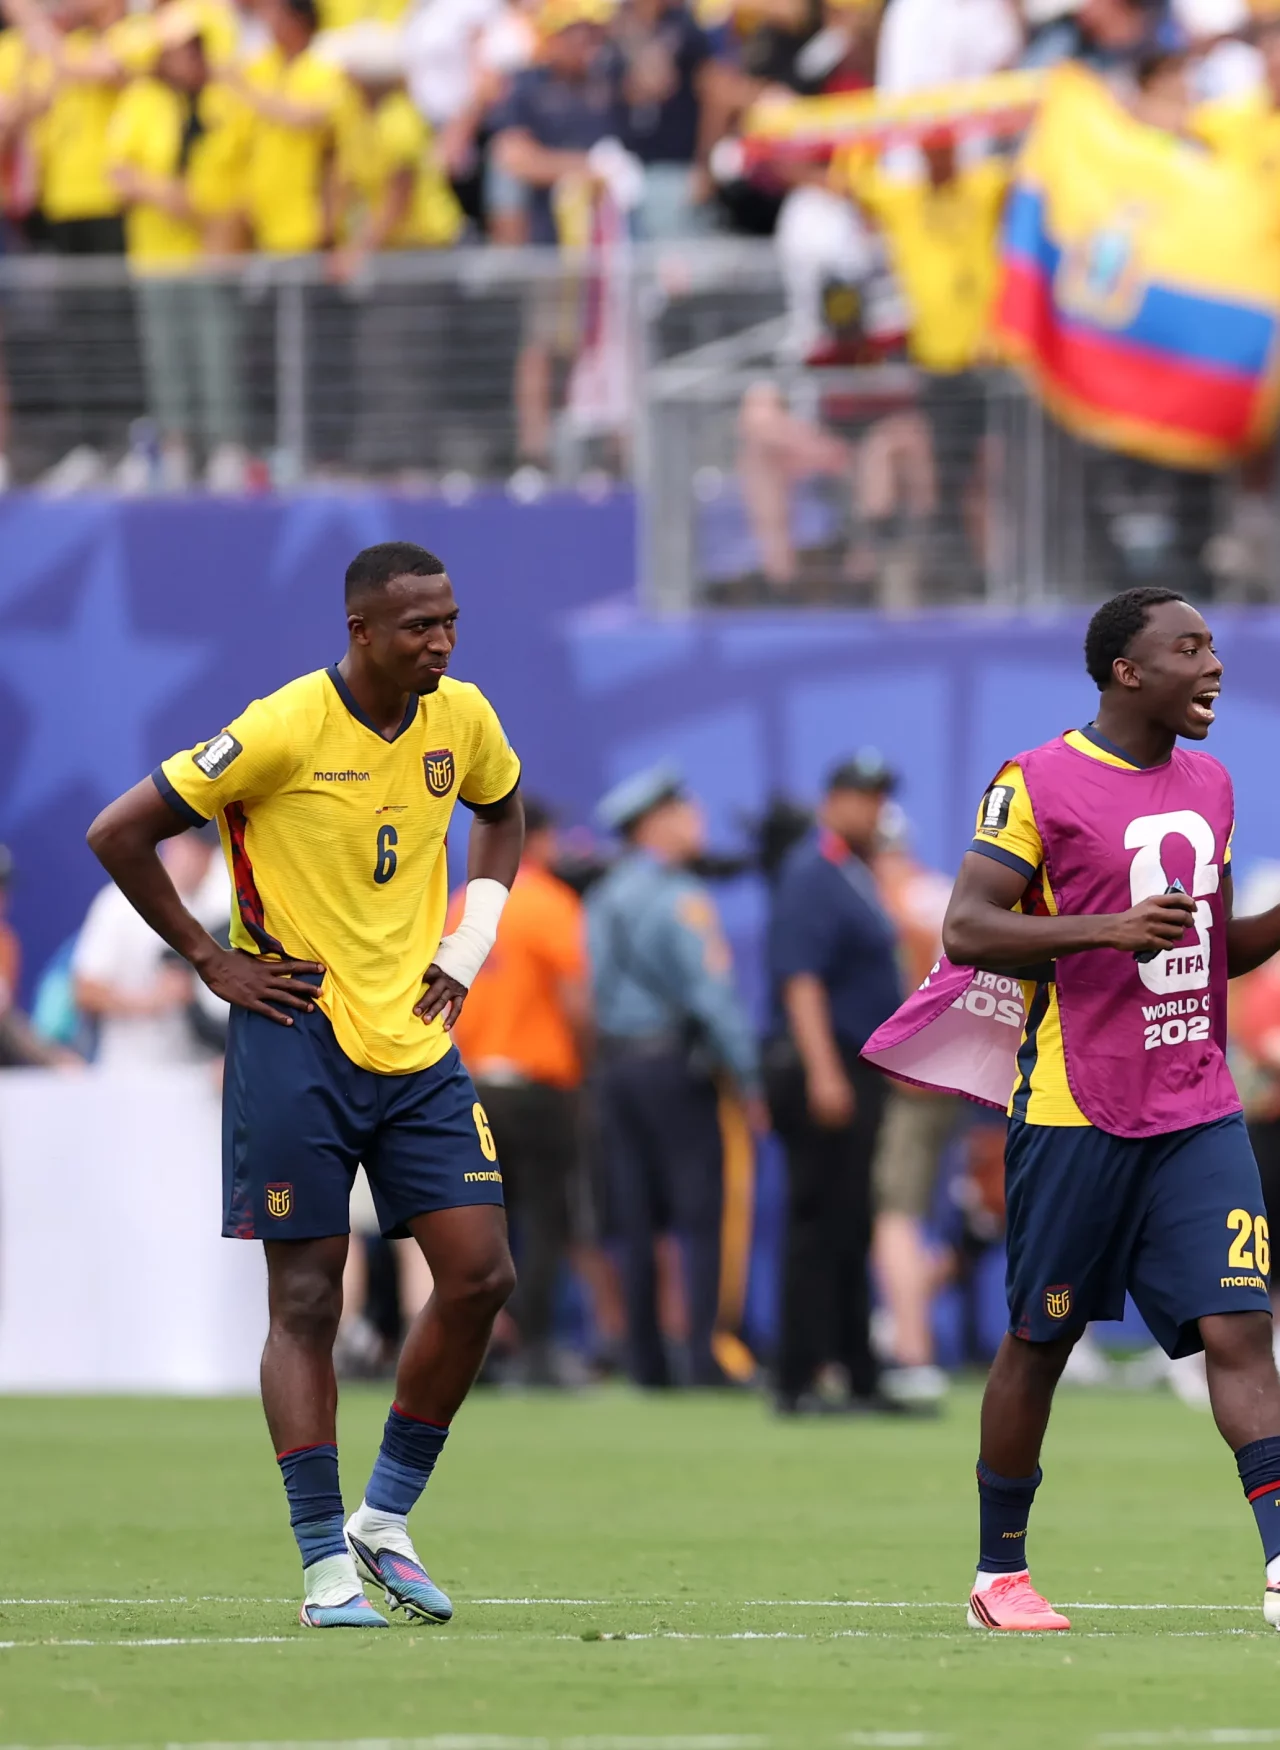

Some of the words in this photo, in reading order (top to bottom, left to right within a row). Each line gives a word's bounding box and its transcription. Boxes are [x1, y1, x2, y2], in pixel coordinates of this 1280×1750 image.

[313, 770, 370, 782] marathon
[373, 824, 398, 884] 6
[1165, 954, 1204, 977] FIFA
[1141, 998, 1199, 1021] WORLD
[472, 1102, 497, 1162] 6
[1226, 1208, 1270, 1276] 26
